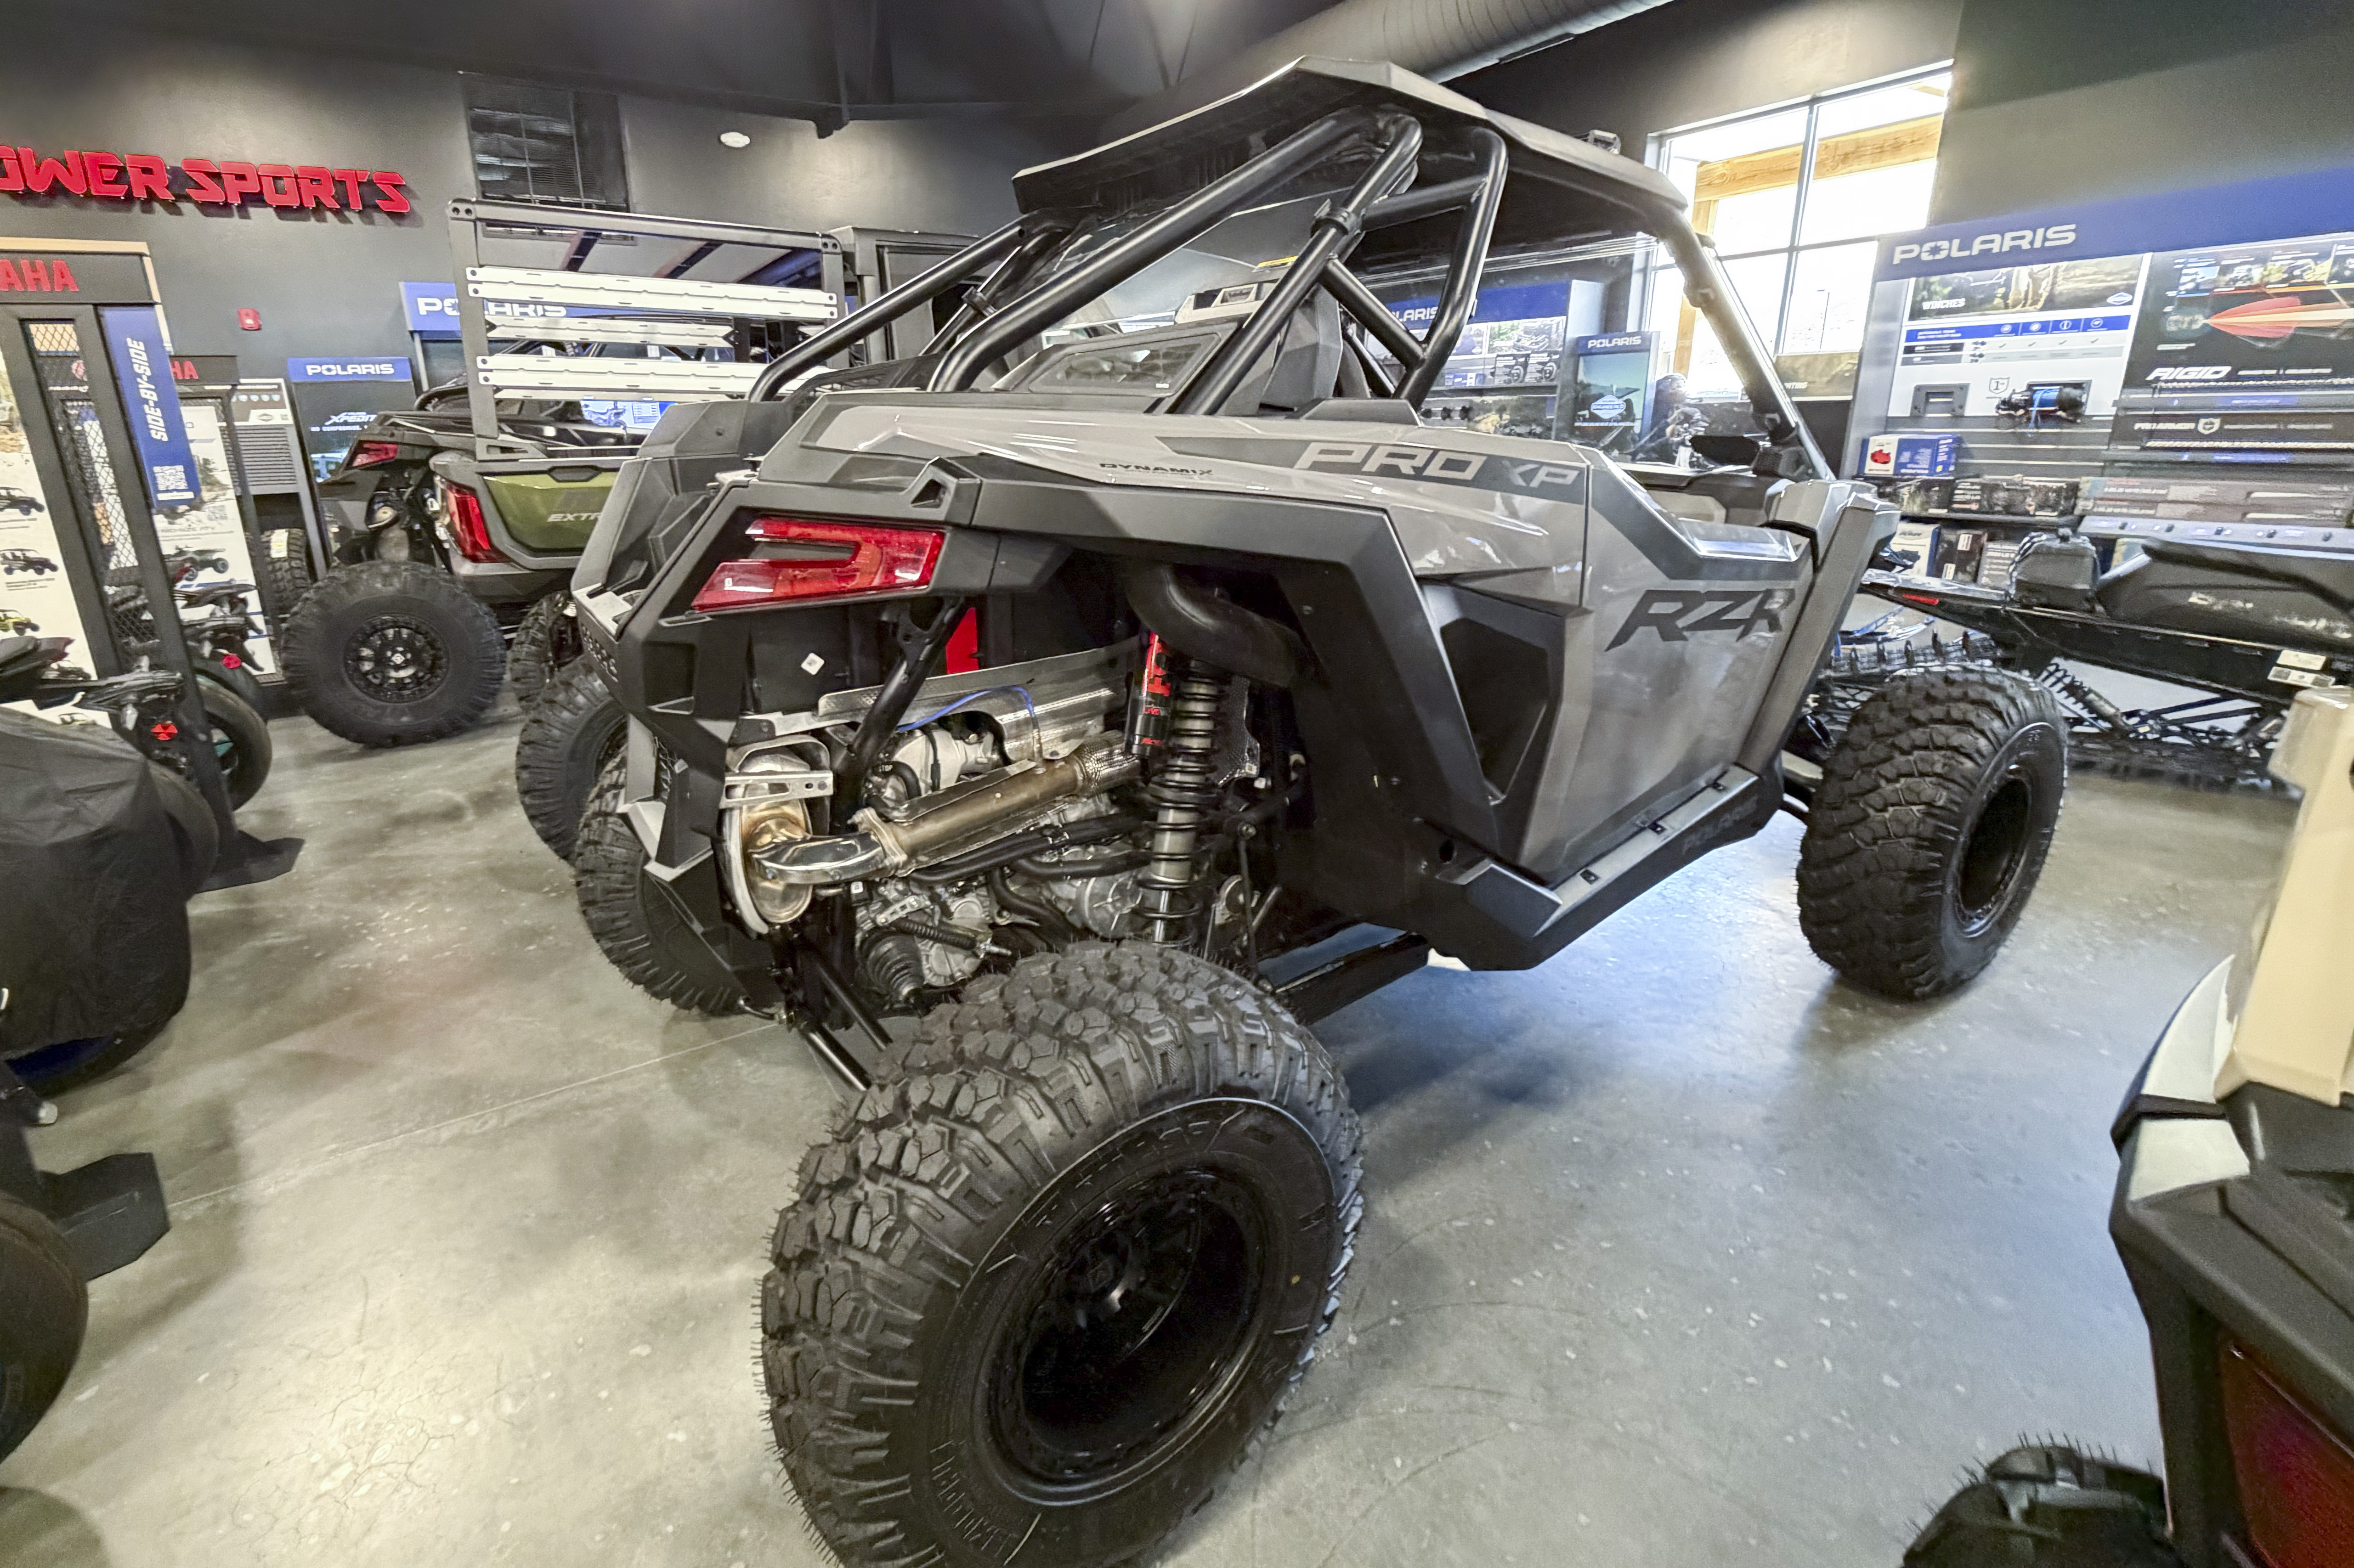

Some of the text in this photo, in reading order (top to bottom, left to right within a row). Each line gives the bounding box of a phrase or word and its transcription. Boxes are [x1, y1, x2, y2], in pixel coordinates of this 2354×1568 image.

[181, 159, 410, 213] SPORTS
[1893, 224, 2076, 265] POLARIS
[1588, 336, 1642, 348] POLARIS
[126, 337, 168, 442] SIDE-BY-SIDE
[306, 364, 395, 375] POLARIS
[1100, 463, 1213, 476] DYNAMIX
[1293, 441, 1488, 481] PRO
[1603, 588, 1795, 652] RZR
